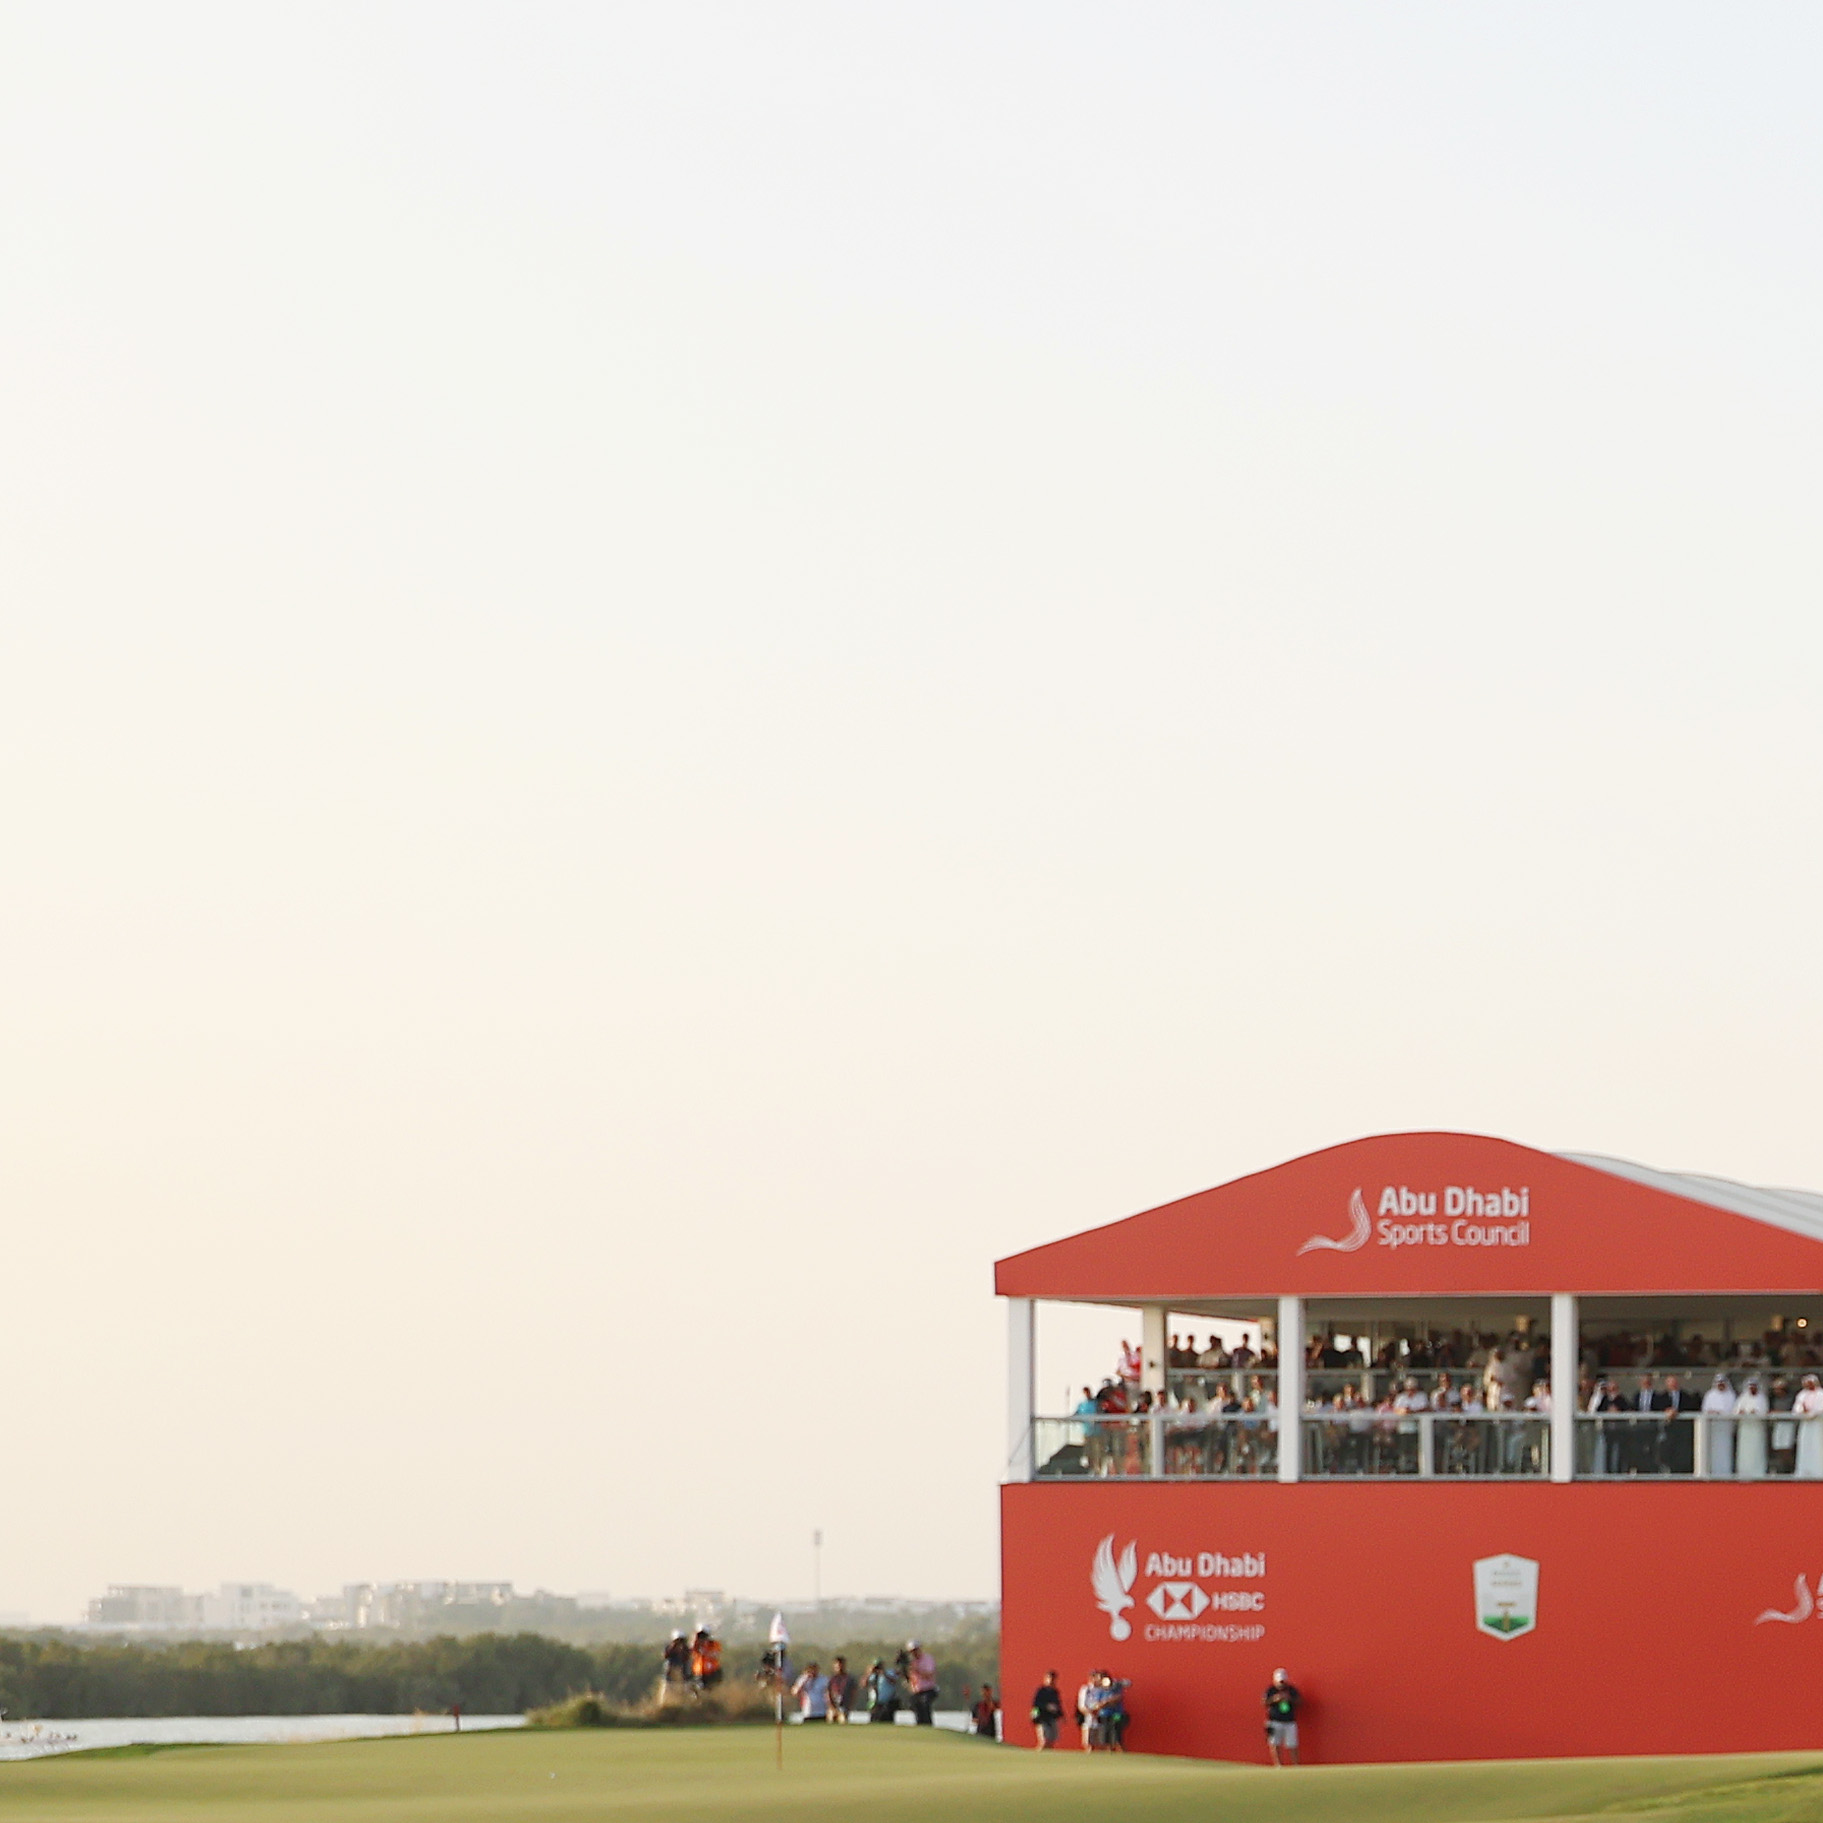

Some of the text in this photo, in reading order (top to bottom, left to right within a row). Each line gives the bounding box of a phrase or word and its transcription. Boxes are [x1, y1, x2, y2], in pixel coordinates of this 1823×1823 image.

[1378, 1186, 1530, 1217] Abu Dhabi
[1377, 1218, 1530, 1250] Sports Council
[1145, 1552, 1266, 1578] Abu Dhabi
[1210, 1592, 1265, 1611] HSBC
[1144, 1624, 1266, 1642] CHAMPIONSHIP
